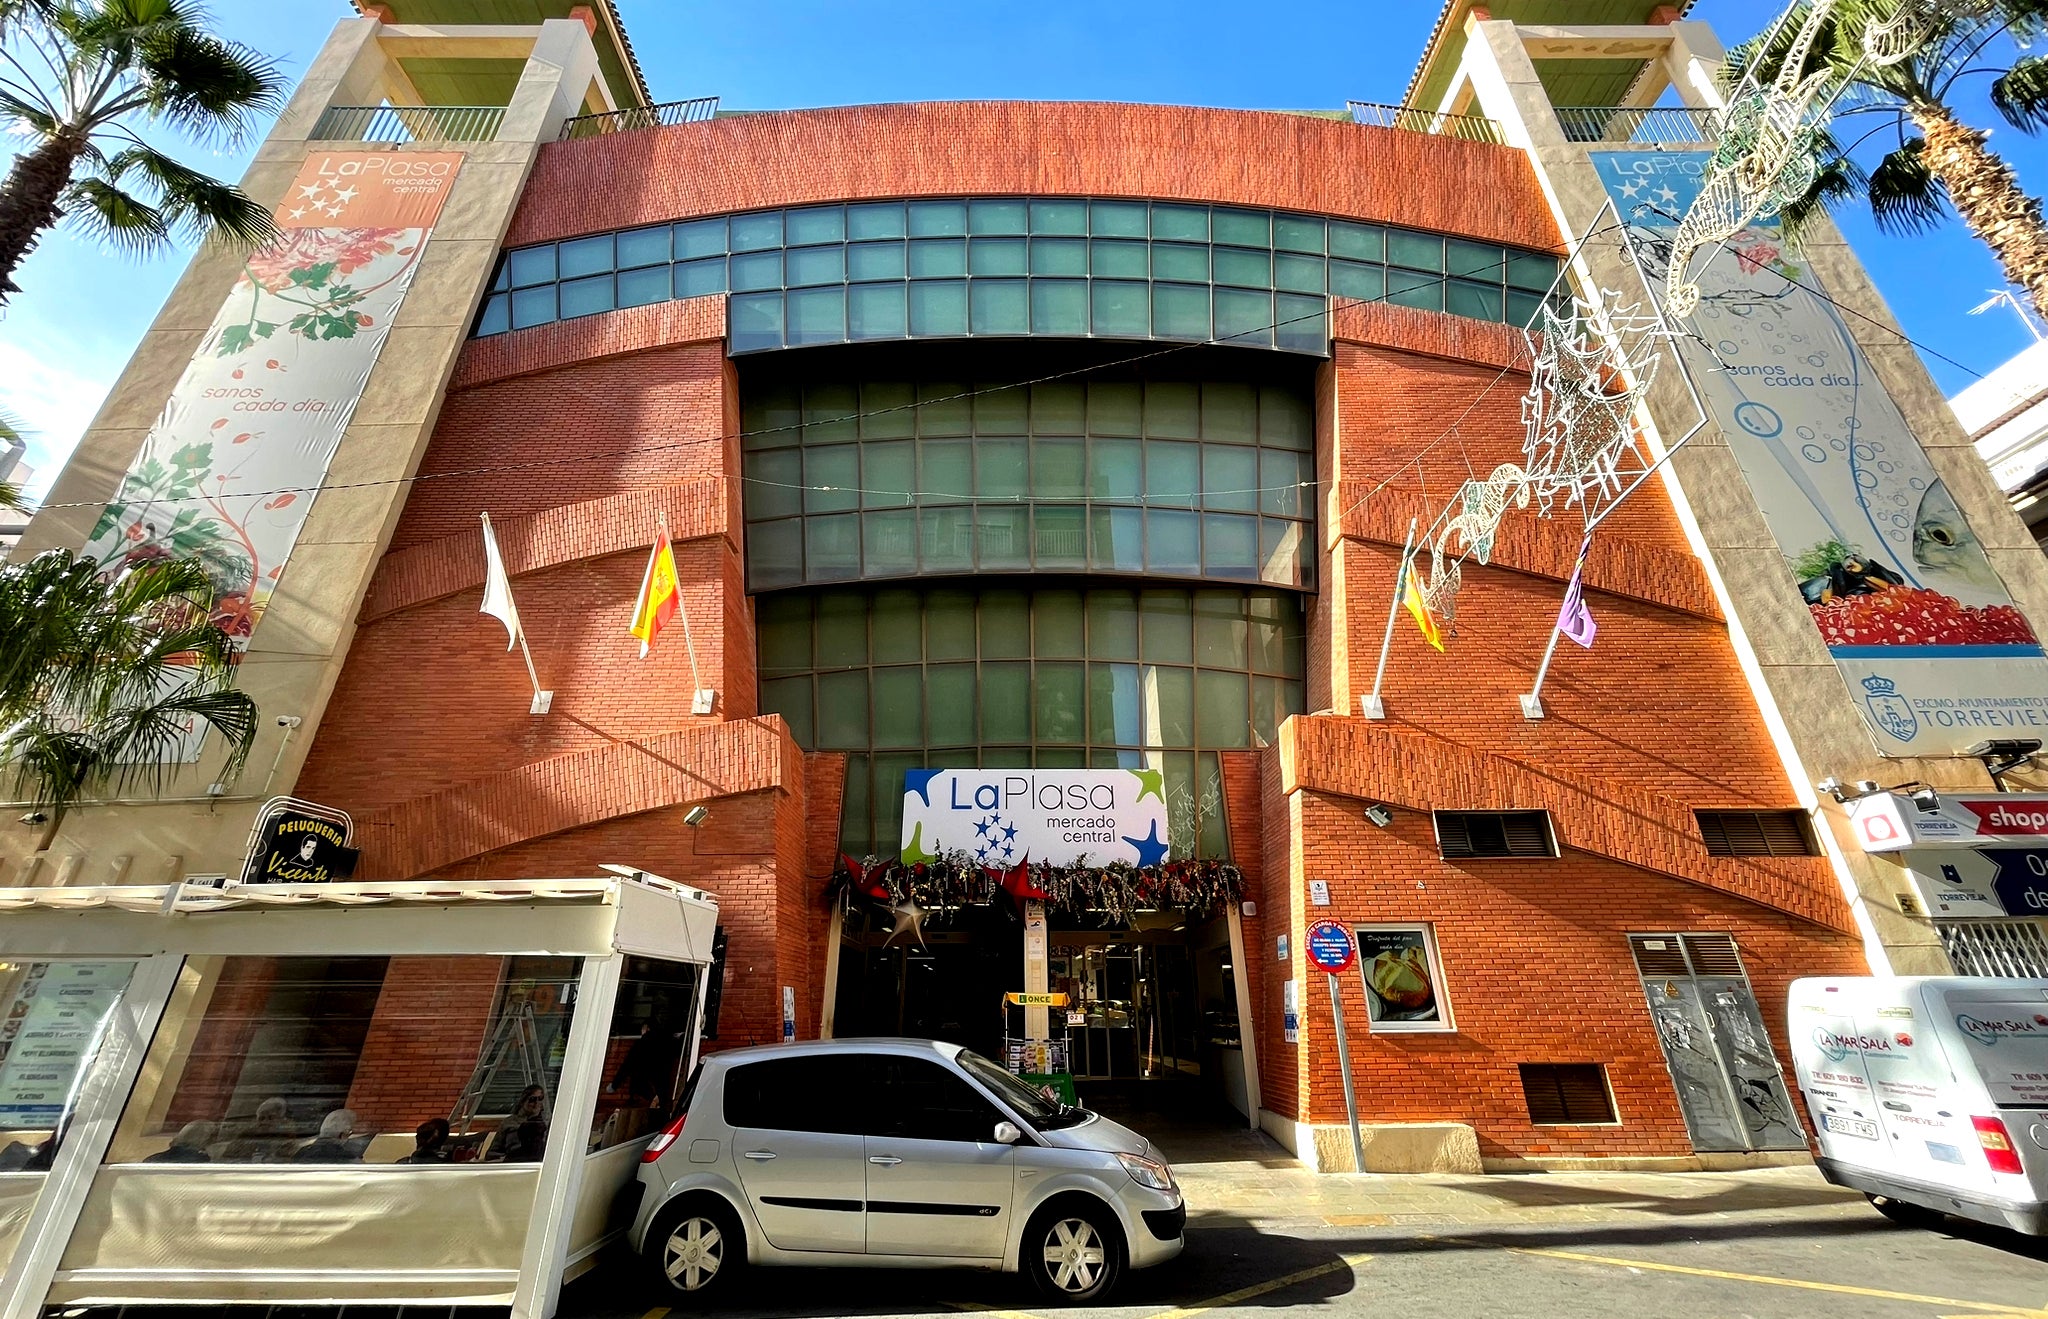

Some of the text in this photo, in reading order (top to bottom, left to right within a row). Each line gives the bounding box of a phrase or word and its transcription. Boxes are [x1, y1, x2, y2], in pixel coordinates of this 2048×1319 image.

[318, 156, 452, 176] LaPlasa
[1610, 156, 1707, 175] LaPla
[383, 177, 443, 185] mercado
[393, 184, 440, 193] central
[1764, 374, 1814, 387] cada
[201, 388, 264, 398] sanos
[233, 399, 288, 412] cada
[1913, 698, 1957, 709] EXCMO.
[1958, 698, 2043, 708] AYUNTAMIENTO
[951, 775, 1115, 810] LaPlasa
[1047, 815, 1116, 828] mercado
[278, 820, 343, 847] PELUQUERIA
[1063, 829, 1116, 843] central
[267, 851, 328, 882] Vicente
[1937, 893, 1988, 902] TORREVIEJA
[1028, 995, 1051, 1004] ONCE
[1965, 1021, 1982, 1032] LA
[1981, 1020, 2006, 1032] MAR
[1819, 1034, 1834, 1047] LA
[1834, 1035, 1860, 1049] MAR
